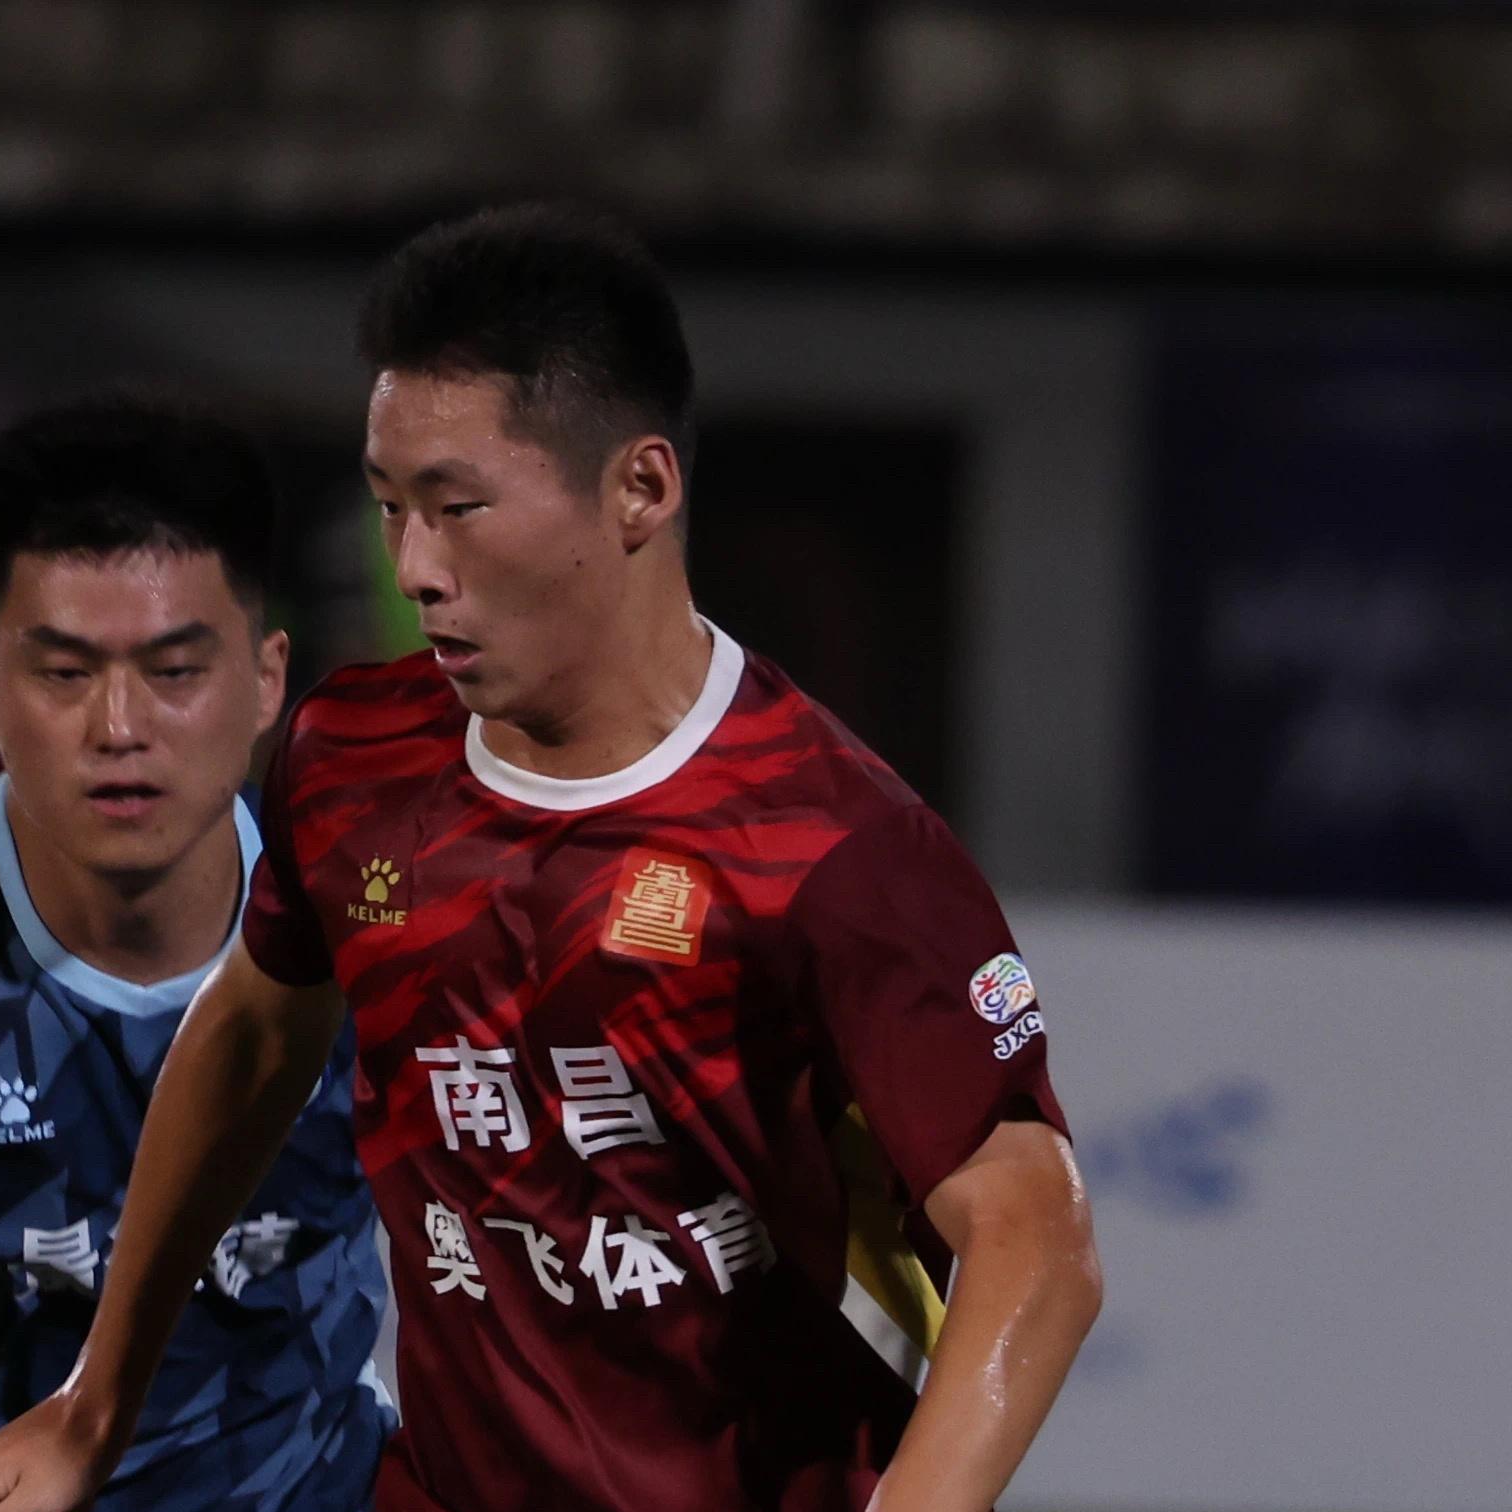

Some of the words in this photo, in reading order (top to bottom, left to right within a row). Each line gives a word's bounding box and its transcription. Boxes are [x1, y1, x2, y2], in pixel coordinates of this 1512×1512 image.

[347, 902, 408, 926] KELME
[416, 1034, 667, 1160] 南昌
[424, 1191, 778, 1310] 奥飞体育
